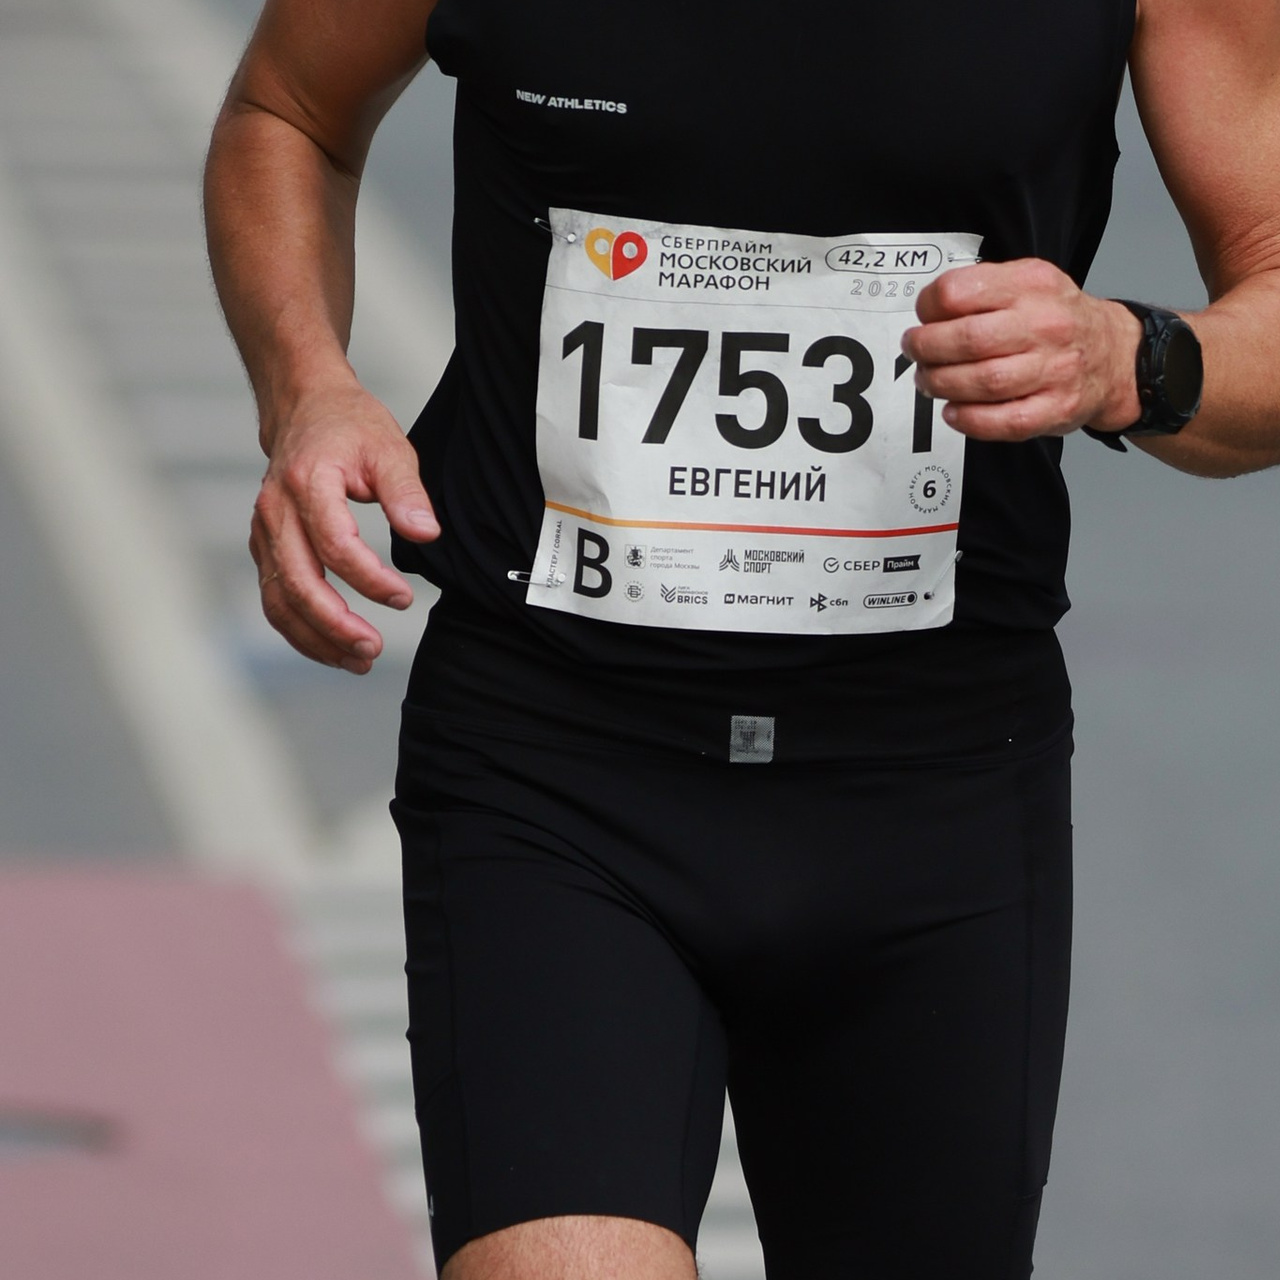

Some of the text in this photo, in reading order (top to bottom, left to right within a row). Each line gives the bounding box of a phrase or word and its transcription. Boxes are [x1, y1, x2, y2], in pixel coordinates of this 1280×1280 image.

[516, 89, 627, 114] NEW ATHLETICS
[661, 235, 772, 254] СБЕРПРАЙМ
[659, 252, 812, 274] МОСКОВСКИЙ
[838, 249, 886, 269] 42,2
[658, 271, 771, 291] МАРАФОН
[850, 279, 916, 298] 2026
[668, 465, 827, 502] ЕВГЕНИЙ
[923, 480, 937, 499] 6
[744, 549, 805, 564] МОСКОВСКИЙ
[843, 560, 881, 571] СБЕР
[743, 561, 772, 574] СПОРТ
[677, 594, 708, 605] BRICS
[867, 595, 907, 606] WINLINE
